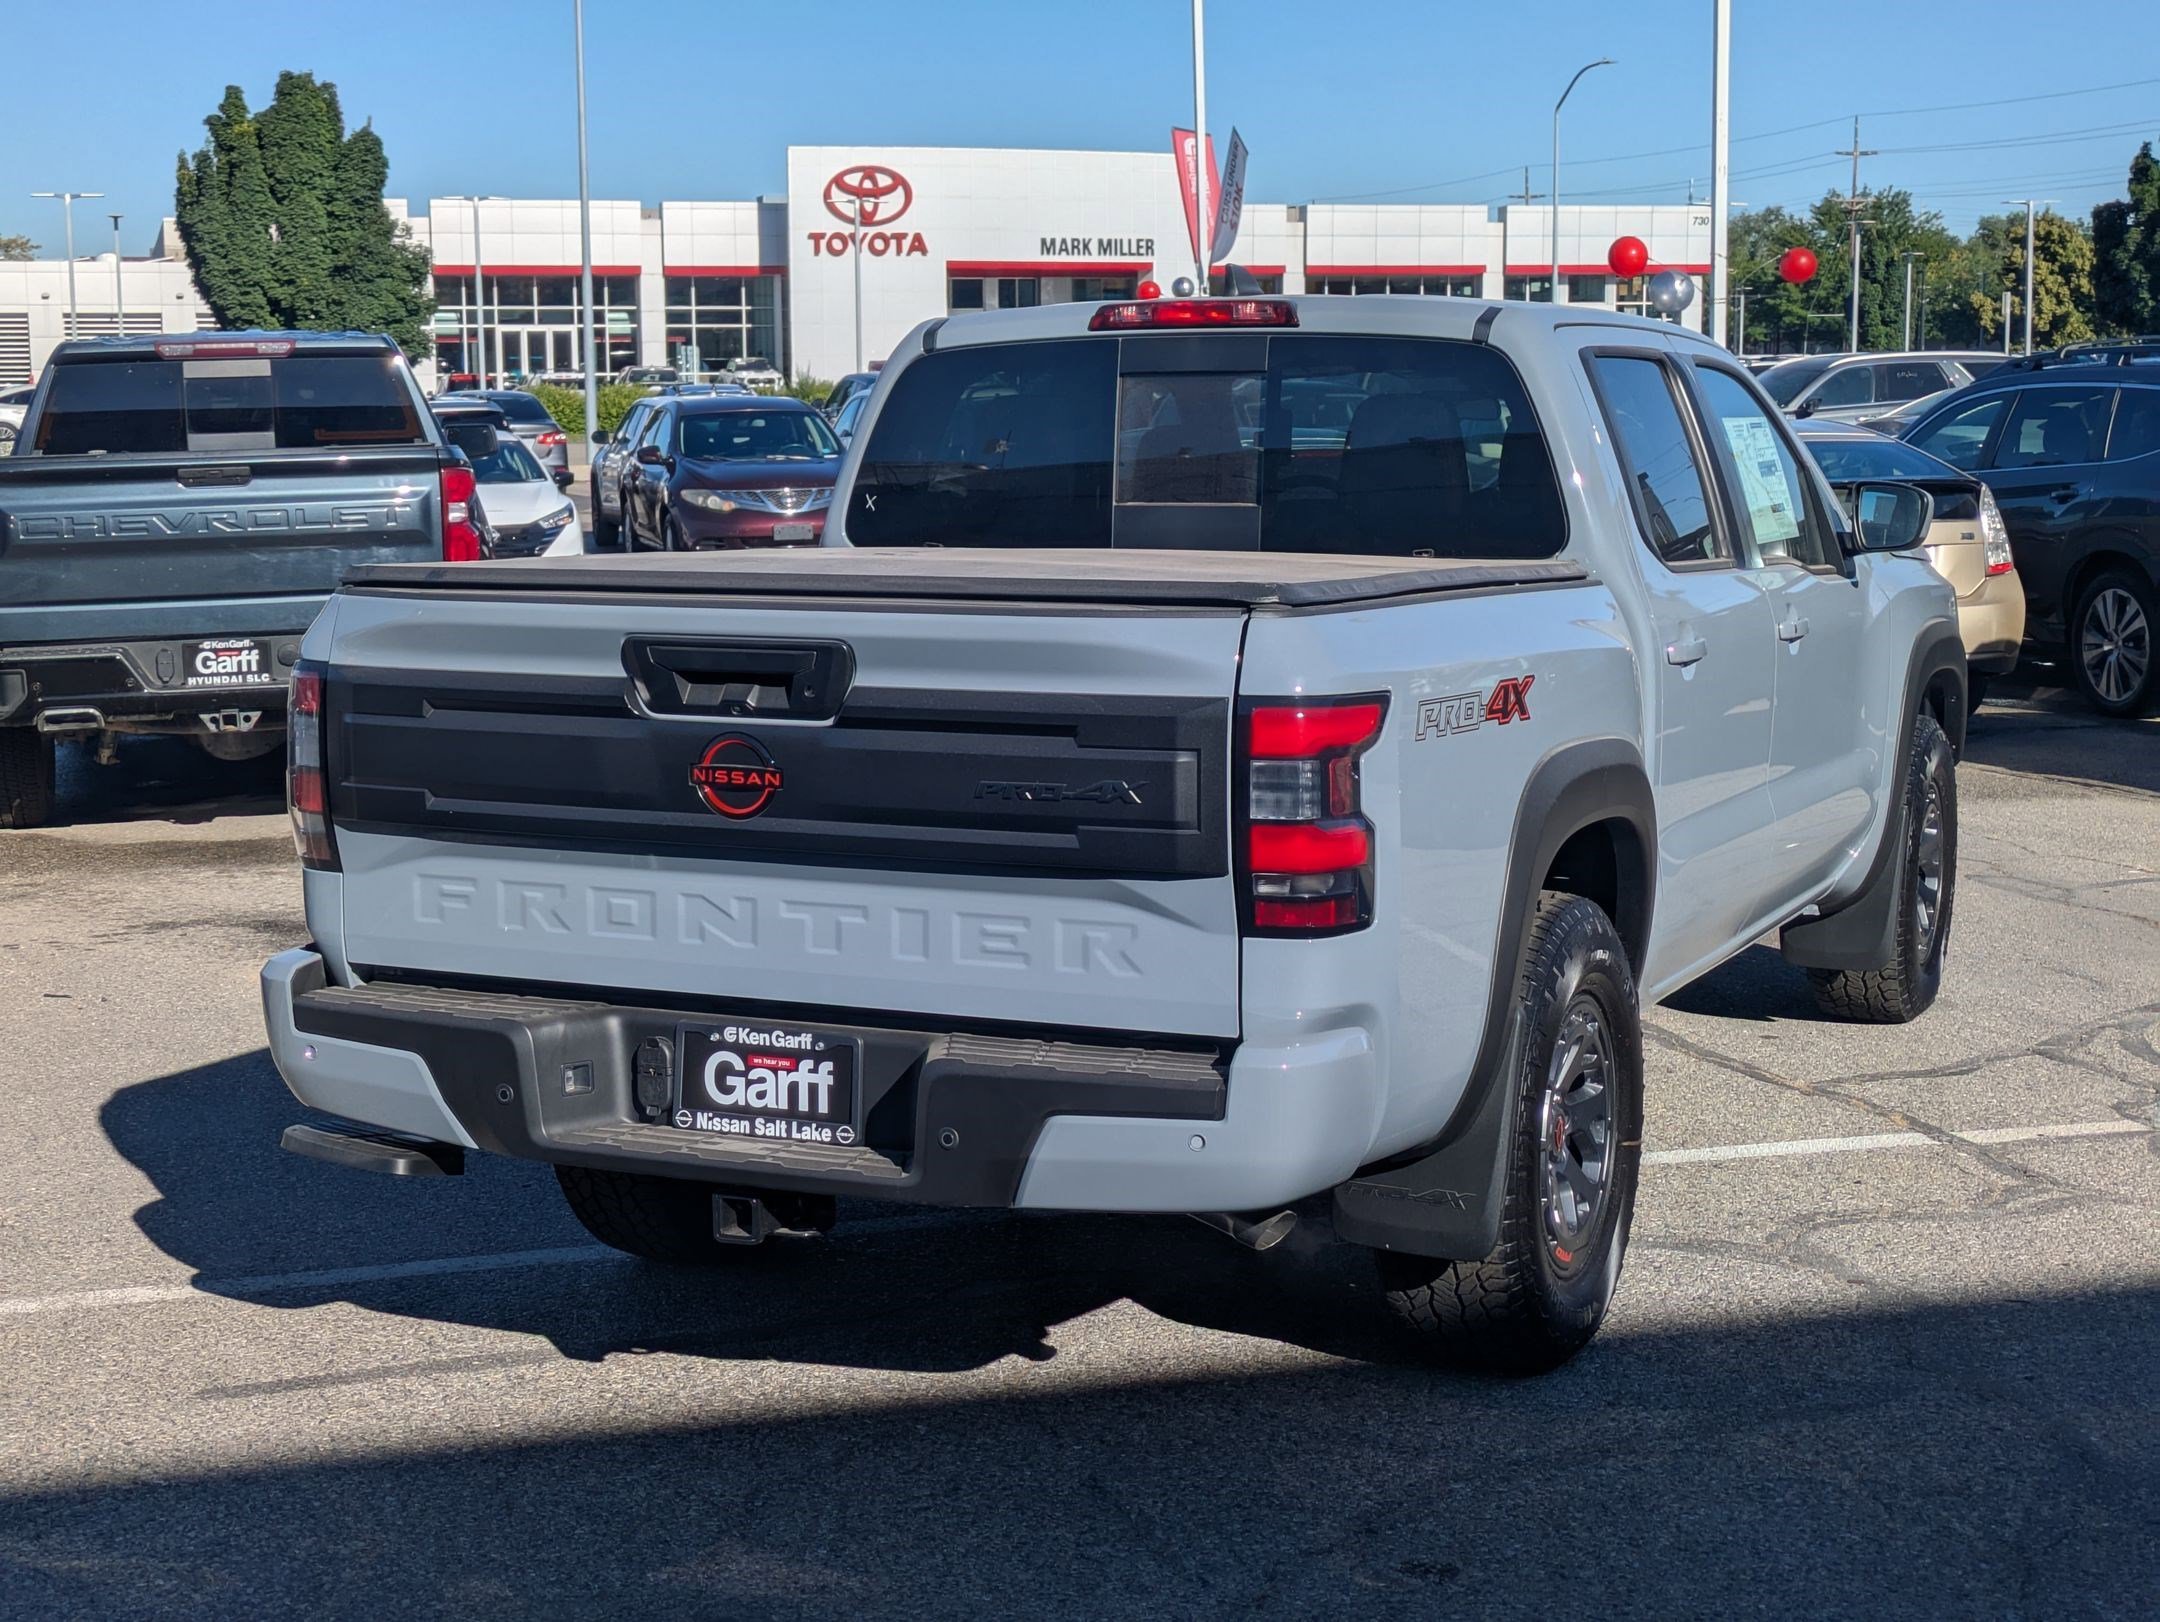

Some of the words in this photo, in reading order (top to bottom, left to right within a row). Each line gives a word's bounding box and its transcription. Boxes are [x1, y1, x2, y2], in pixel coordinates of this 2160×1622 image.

[1220, 190, 1233, 225] CARS
[1227, 141, 1241, 188] UNDER
[1692, 216, 1710, 226] 730
[807, 231, 929, 257] TOYOTA
[1040, 237, 1093, 256] MARK
[1098, 238, 1155, 257] MILLER
[19, 506, 412, 540] CHEVROLET
[195, 649, 260, 675] Garff
[187, 675, 243, 686] HYUNDAI
[246, 673, 270, 683] SLC
[692, 767, 781, 787] NISSAN
[410, 872, 1144, 978] FRONTIER
[738, 1027, 770, 1046] Ken
[771, 1030, 813, 1050] Garff
[704, 1050, 834, 1114] Garff
[696, 1112, 750, 1134] Nissan
[754, 1117, 788, 1138] Salt
[791, 1122, 832, 1142] Lake
